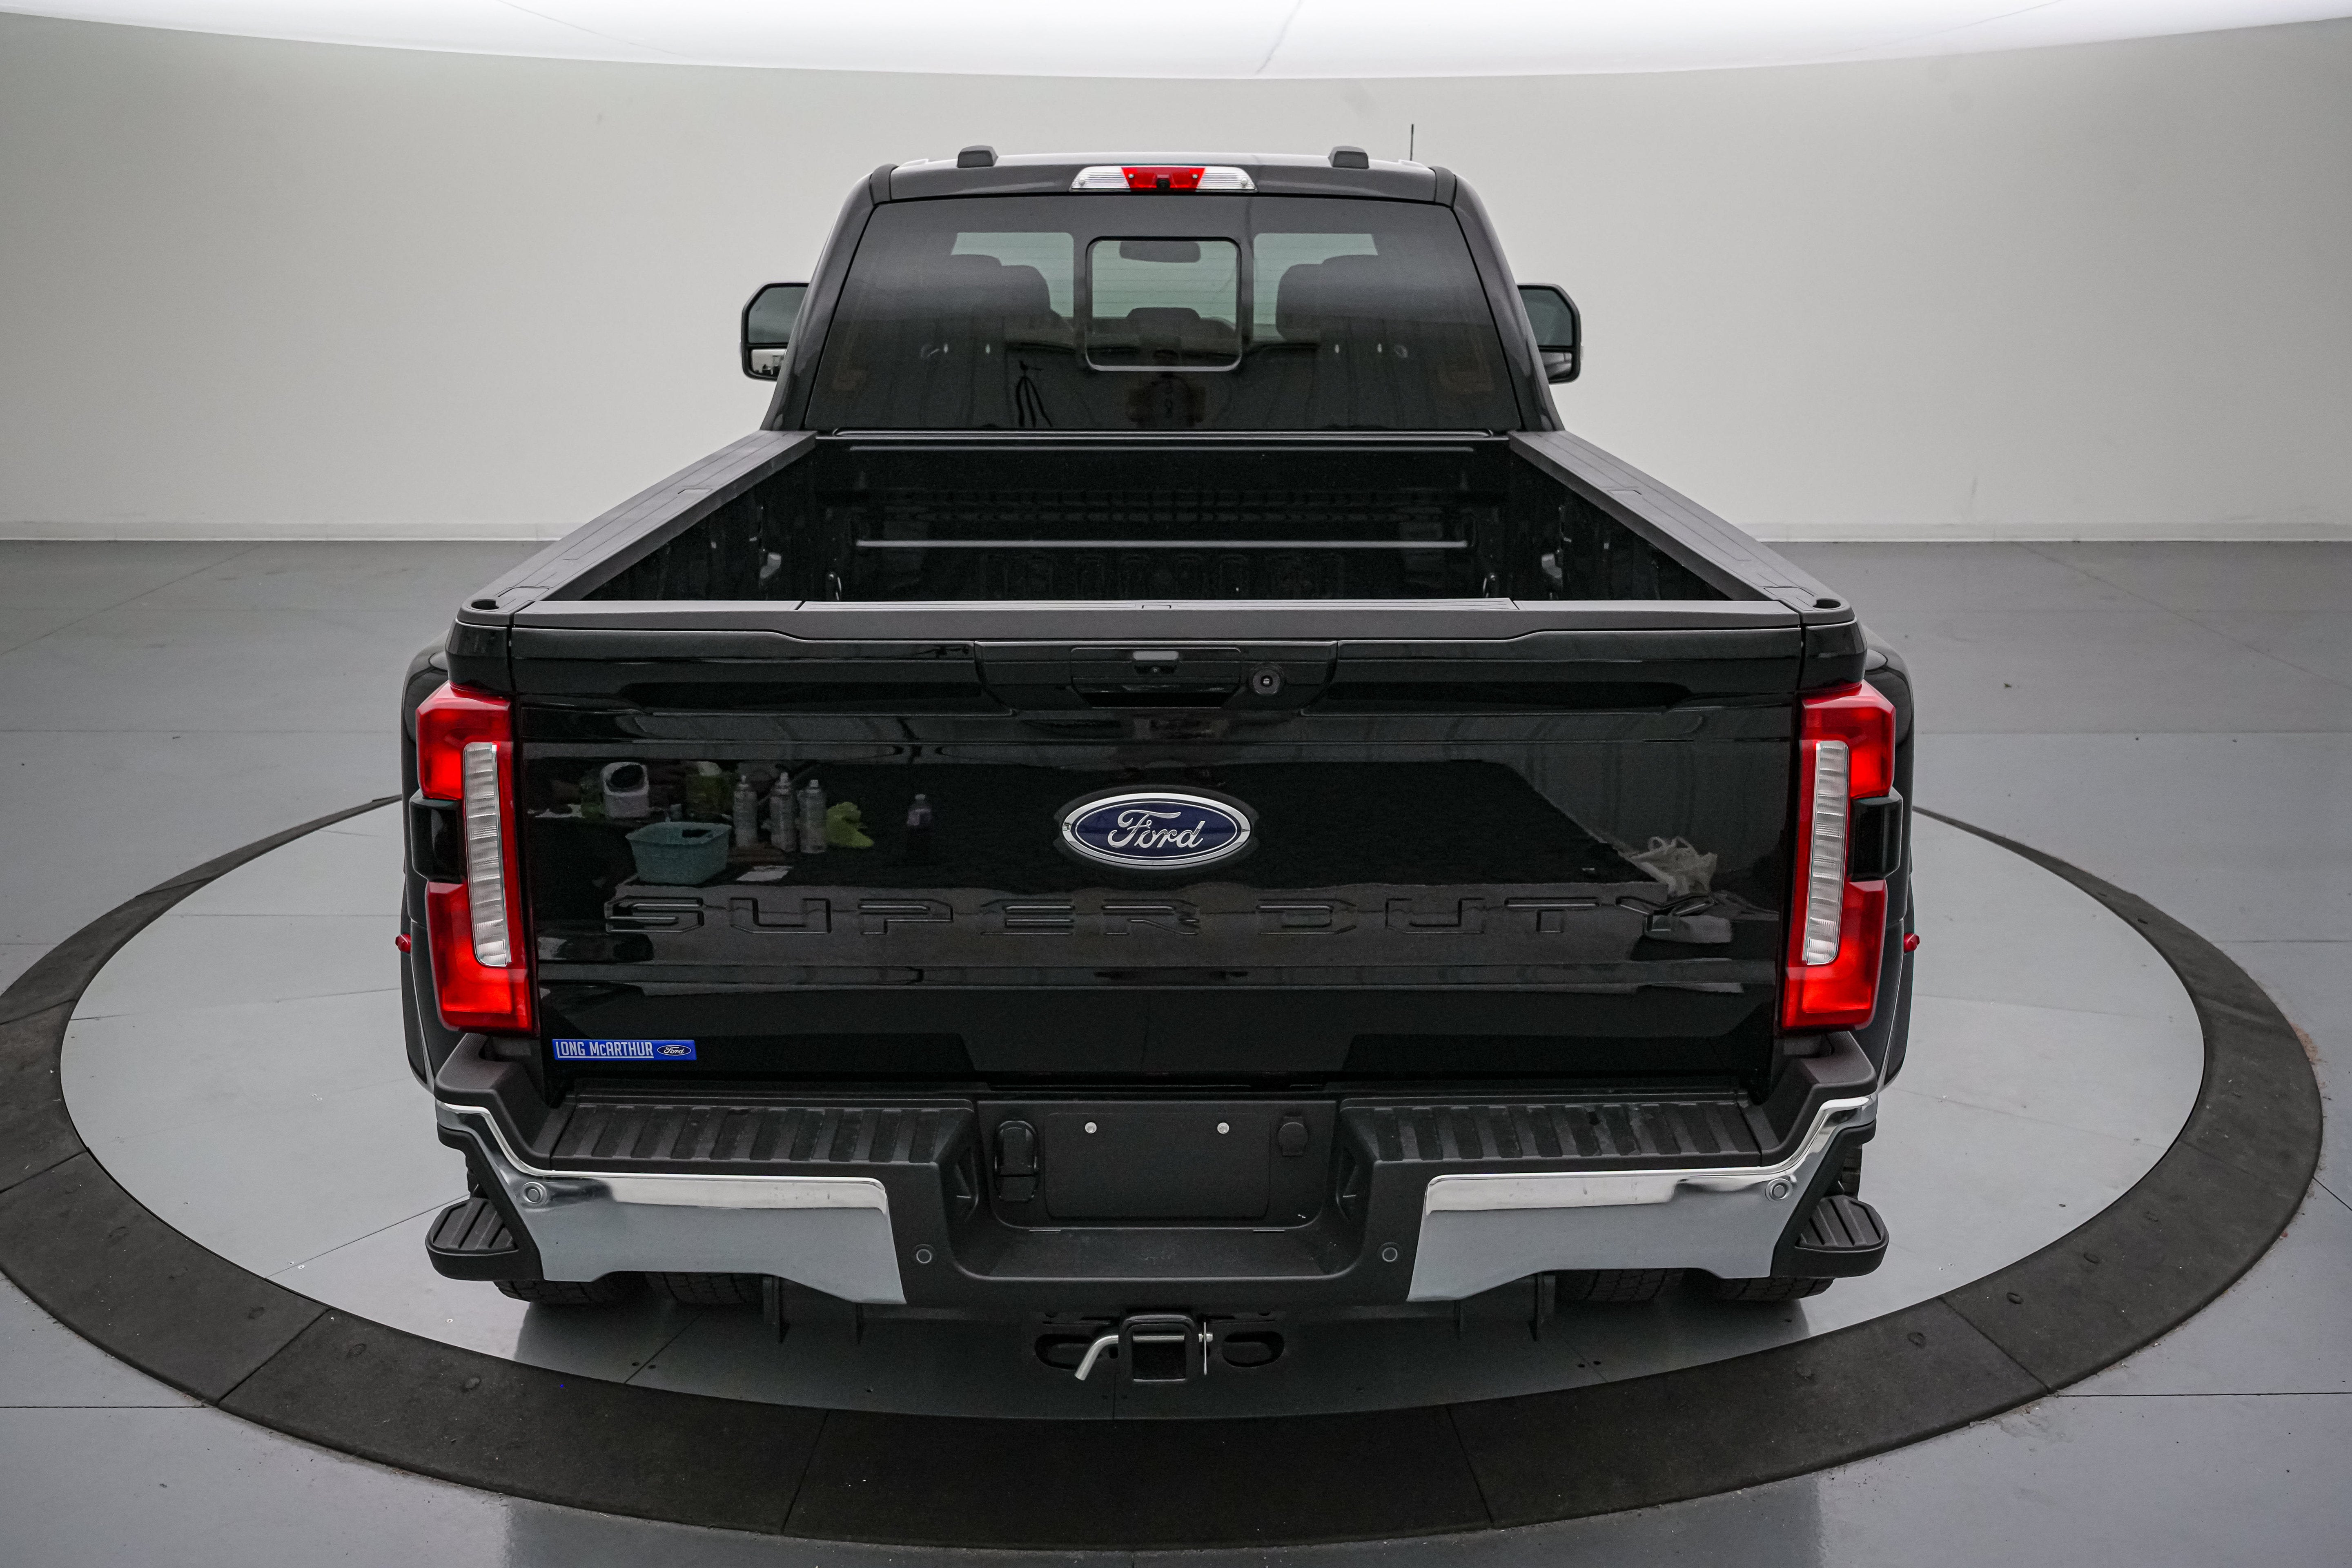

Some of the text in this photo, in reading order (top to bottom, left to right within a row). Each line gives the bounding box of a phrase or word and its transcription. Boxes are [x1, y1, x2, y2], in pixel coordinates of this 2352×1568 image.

[1107, 809, 1205, 848] Ford
[604, 894, 1714, 936] SUPER DUTY
[555, 1041, 586, 1058] LONG
[589, 1042, 653, 1056] McARTHUR
